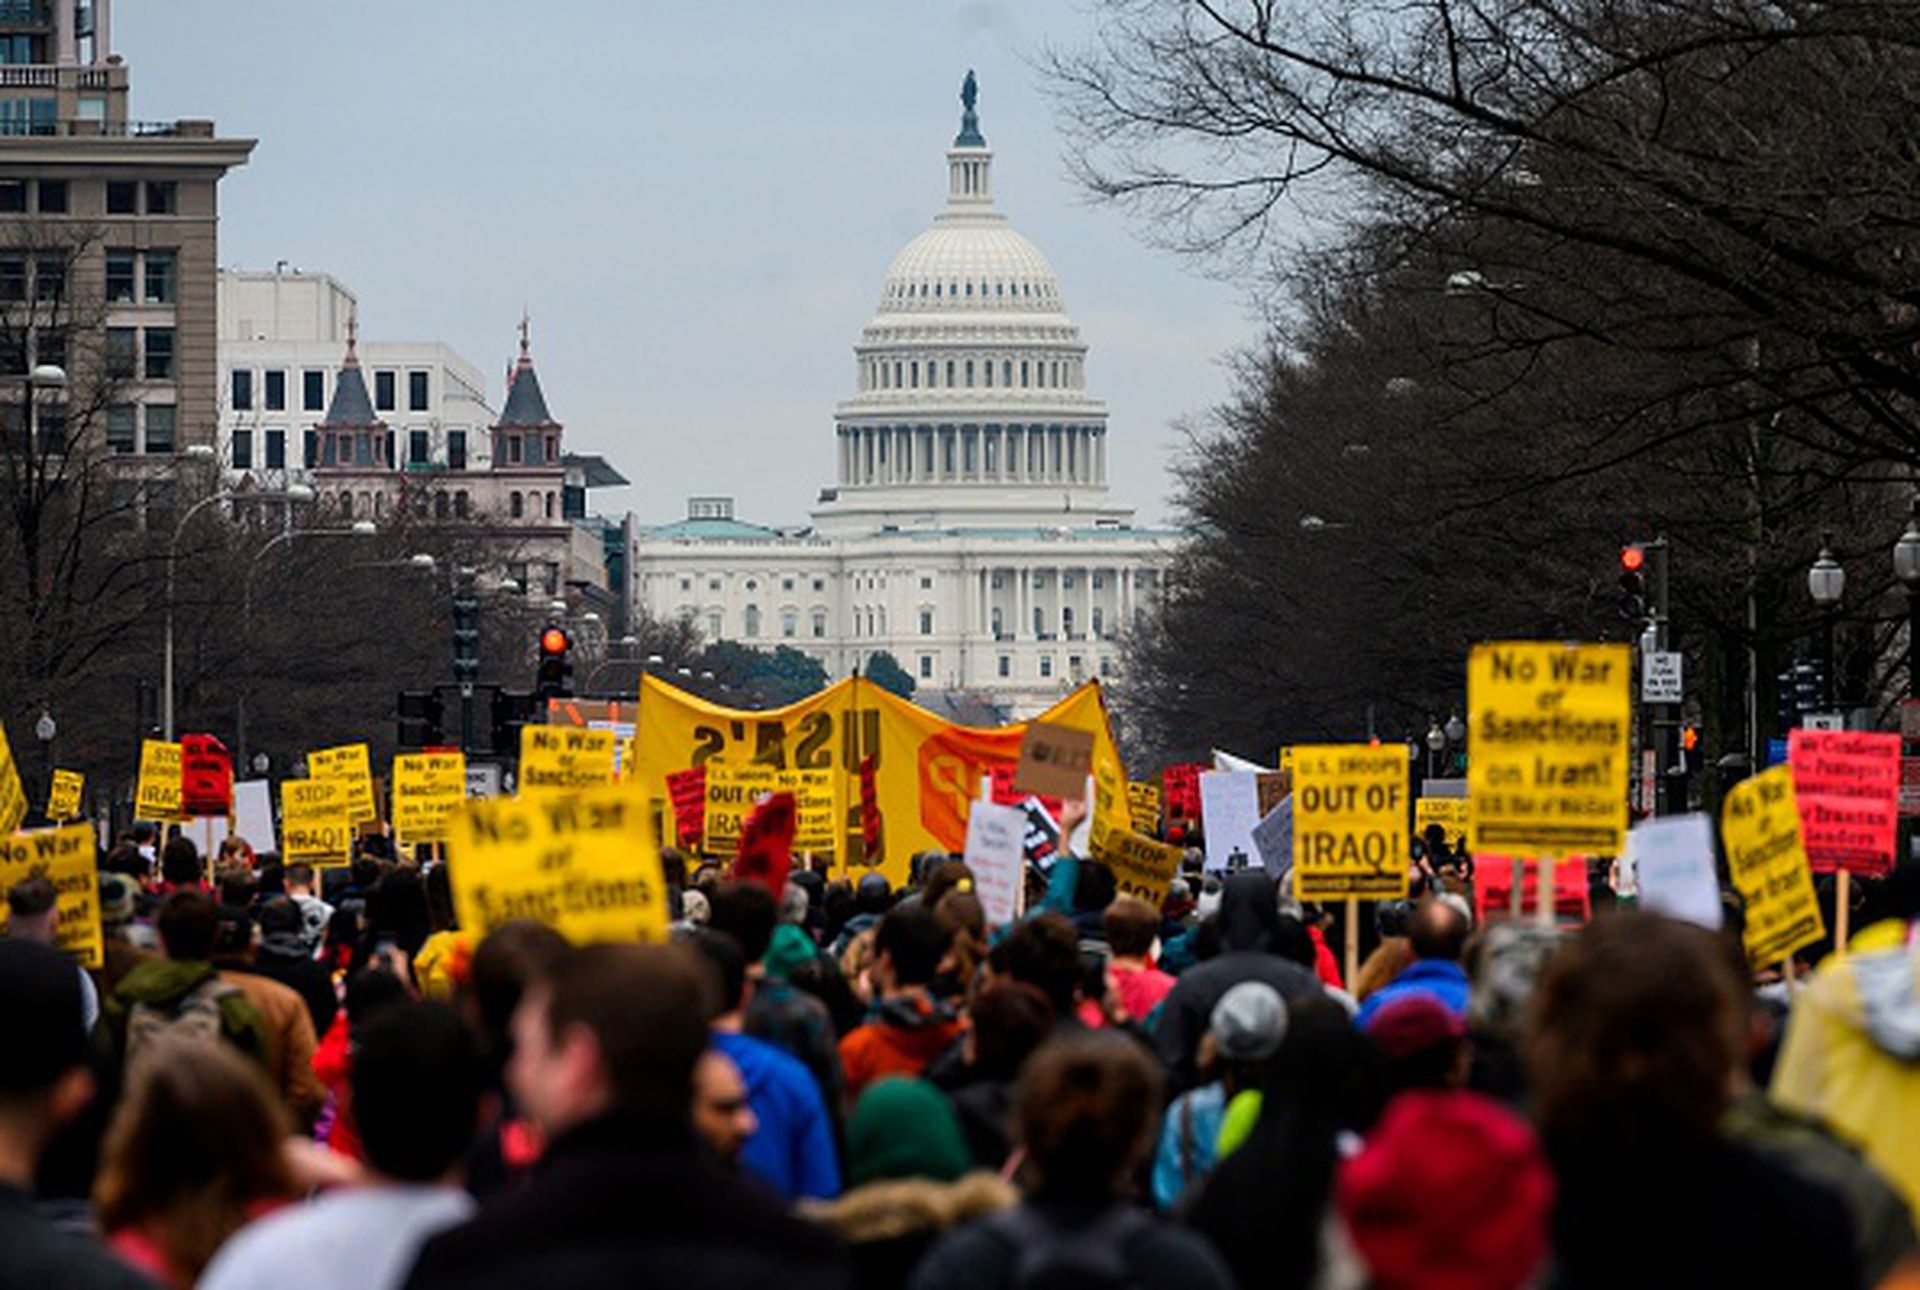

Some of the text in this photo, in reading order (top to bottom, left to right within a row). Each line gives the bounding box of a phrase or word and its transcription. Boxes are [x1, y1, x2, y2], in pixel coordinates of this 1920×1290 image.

[1491, 648, 1612, 684] No War
[1537, 688, 1564, 711] or
[1480, 709, 1618, 746] Sanctions
[532, 731, 606, 752] No War
[153, 747, 180, 764] STO
[403, 757, 459, 771] No War
[1338, 757, 1402, 776] TROOPS
[523, 767, 611, 789] Sanctions
[778, 774, 831, 787] No War
[1485, 752, 1612, 787] on Iran!
[294, 785, 338, 804] STOP
[399, 781, 462, 798] Sanctions
[709, 785, 743, 803] OUT
[1300, 783, 1403, 813] OUT OF
[470, 802, 532, 846] No
[543, 797, 626, 838] War
[710, 813, 743, 835] IRA
[34, 834, 81, 858] War
[1121, 839, 1169, 863] STOP
[1300, 830, 1399, 874] IRAQ!
